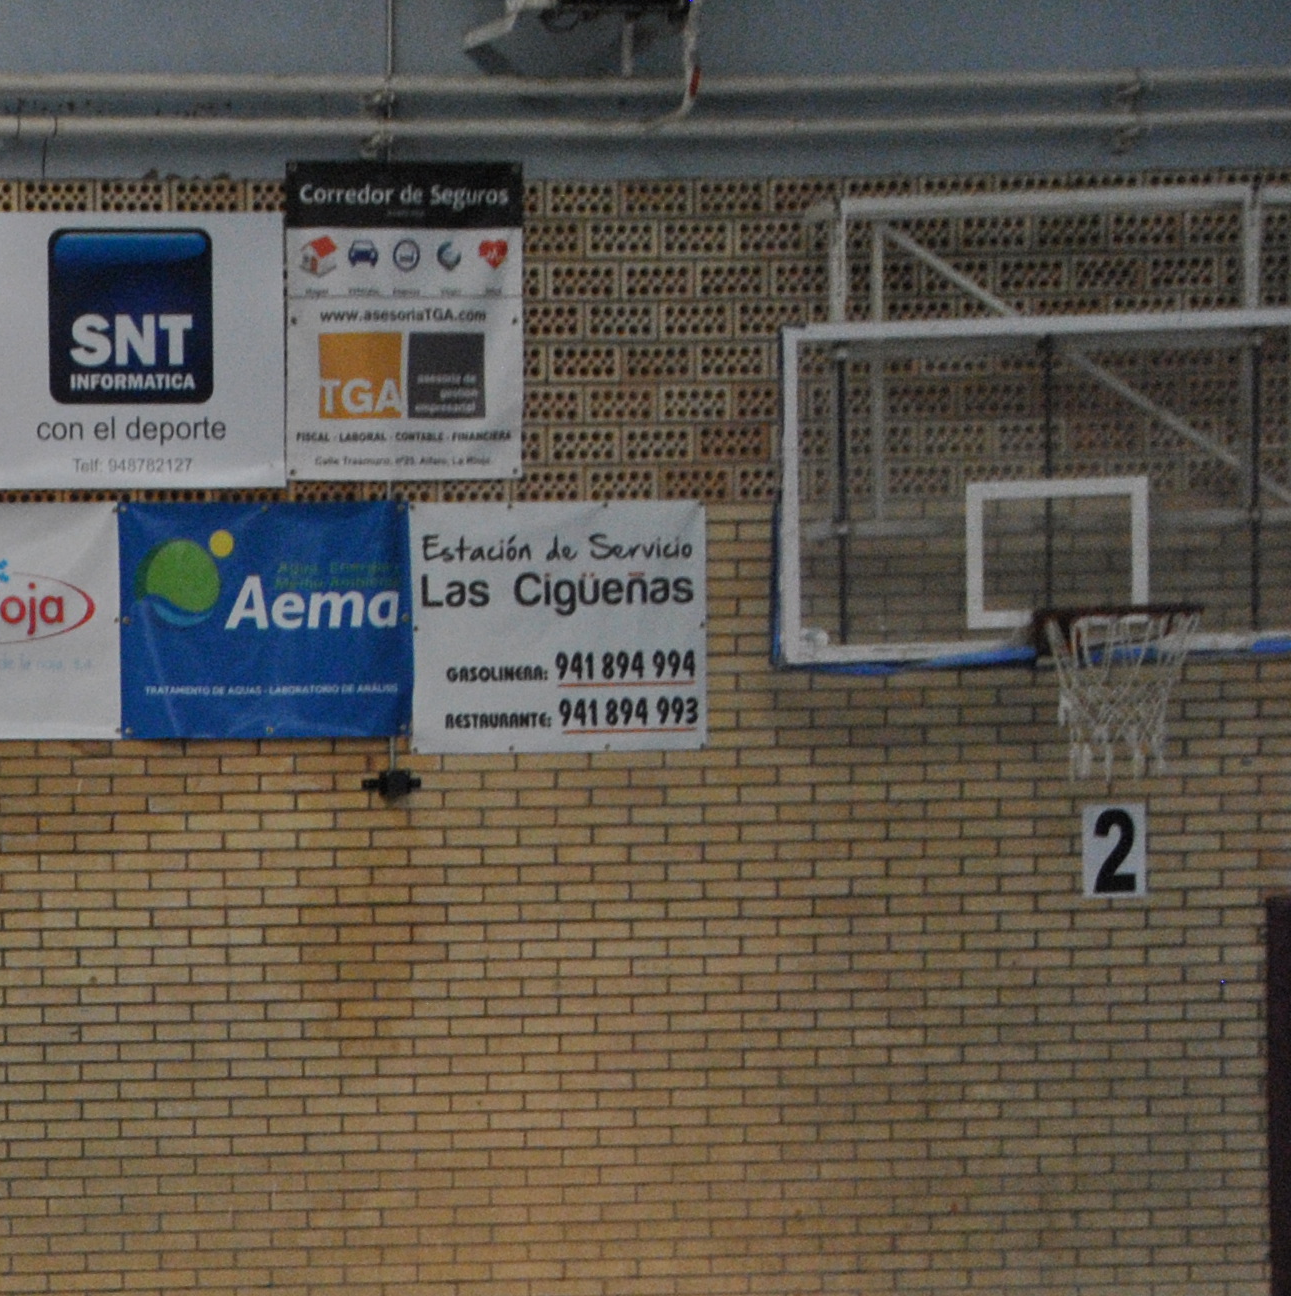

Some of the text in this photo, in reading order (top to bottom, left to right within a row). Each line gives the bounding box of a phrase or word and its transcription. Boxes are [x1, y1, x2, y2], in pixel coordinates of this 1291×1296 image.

[299, 182, 509, 210] Corredor de Seguros
[70, 313, 194, 367] SNT
[70, 373, 196, 391] INFORMATICA
[320, 378, 402, 415] TGA
[36, 417, 227, 446] con el deporte
[422, 532, 693, 563] Estación de Servicio
[225, 575, 400, 631] Aema
[421, 571, 694, 616] Las Cigüeñas
[446, 650, 696, 683] GASOLINERA: 941 894 994
[445, 696, 699, 729] RESTAURANTE: 941 894 993
[1093, 807, 1136, 893] 2
